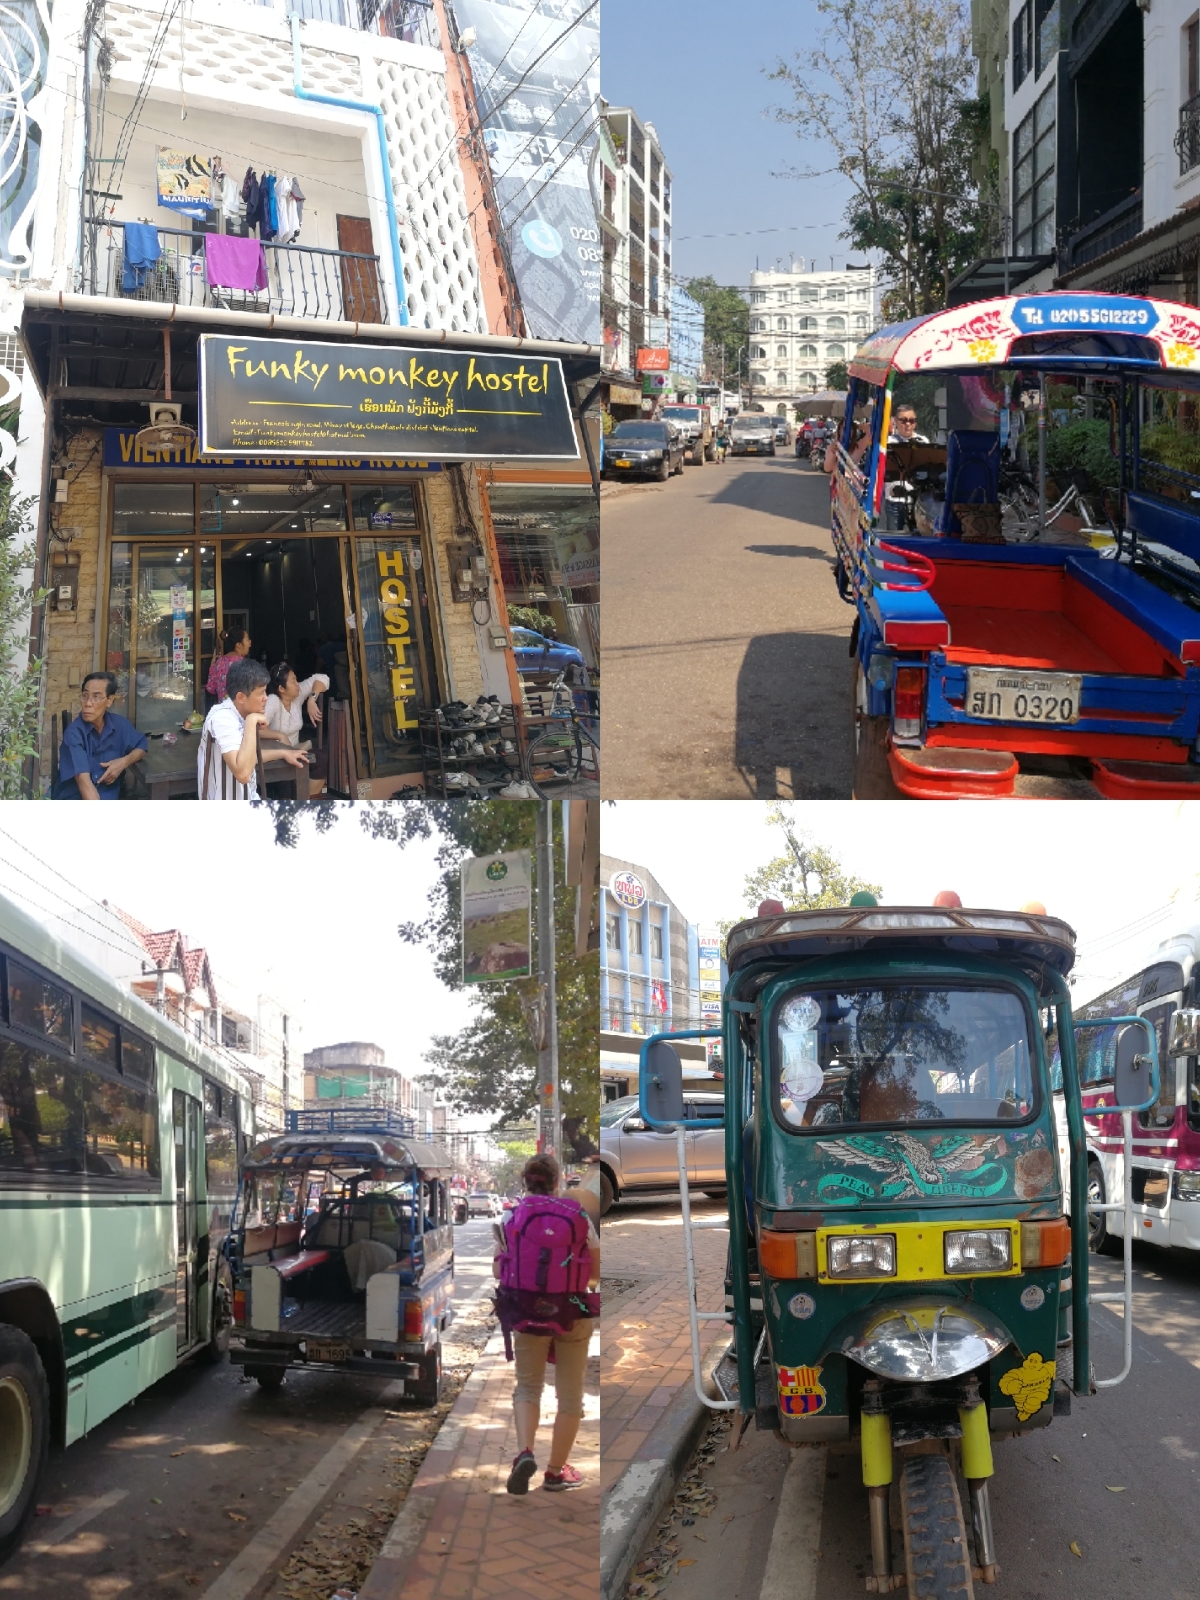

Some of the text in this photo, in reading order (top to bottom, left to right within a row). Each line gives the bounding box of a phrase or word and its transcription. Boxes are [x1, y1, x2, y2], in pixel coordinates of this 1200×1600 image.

[227, 346, 549, 397] Funky monkey hostel
[377, 550, 419, 730] HOSTEL
[1014, 694, 1073, 721] 0320
[700, 938, 719, 946] ATM
[704, 1002, 720, 1010] VISA
[930, 1184, 988, 1197] LIBERTY
